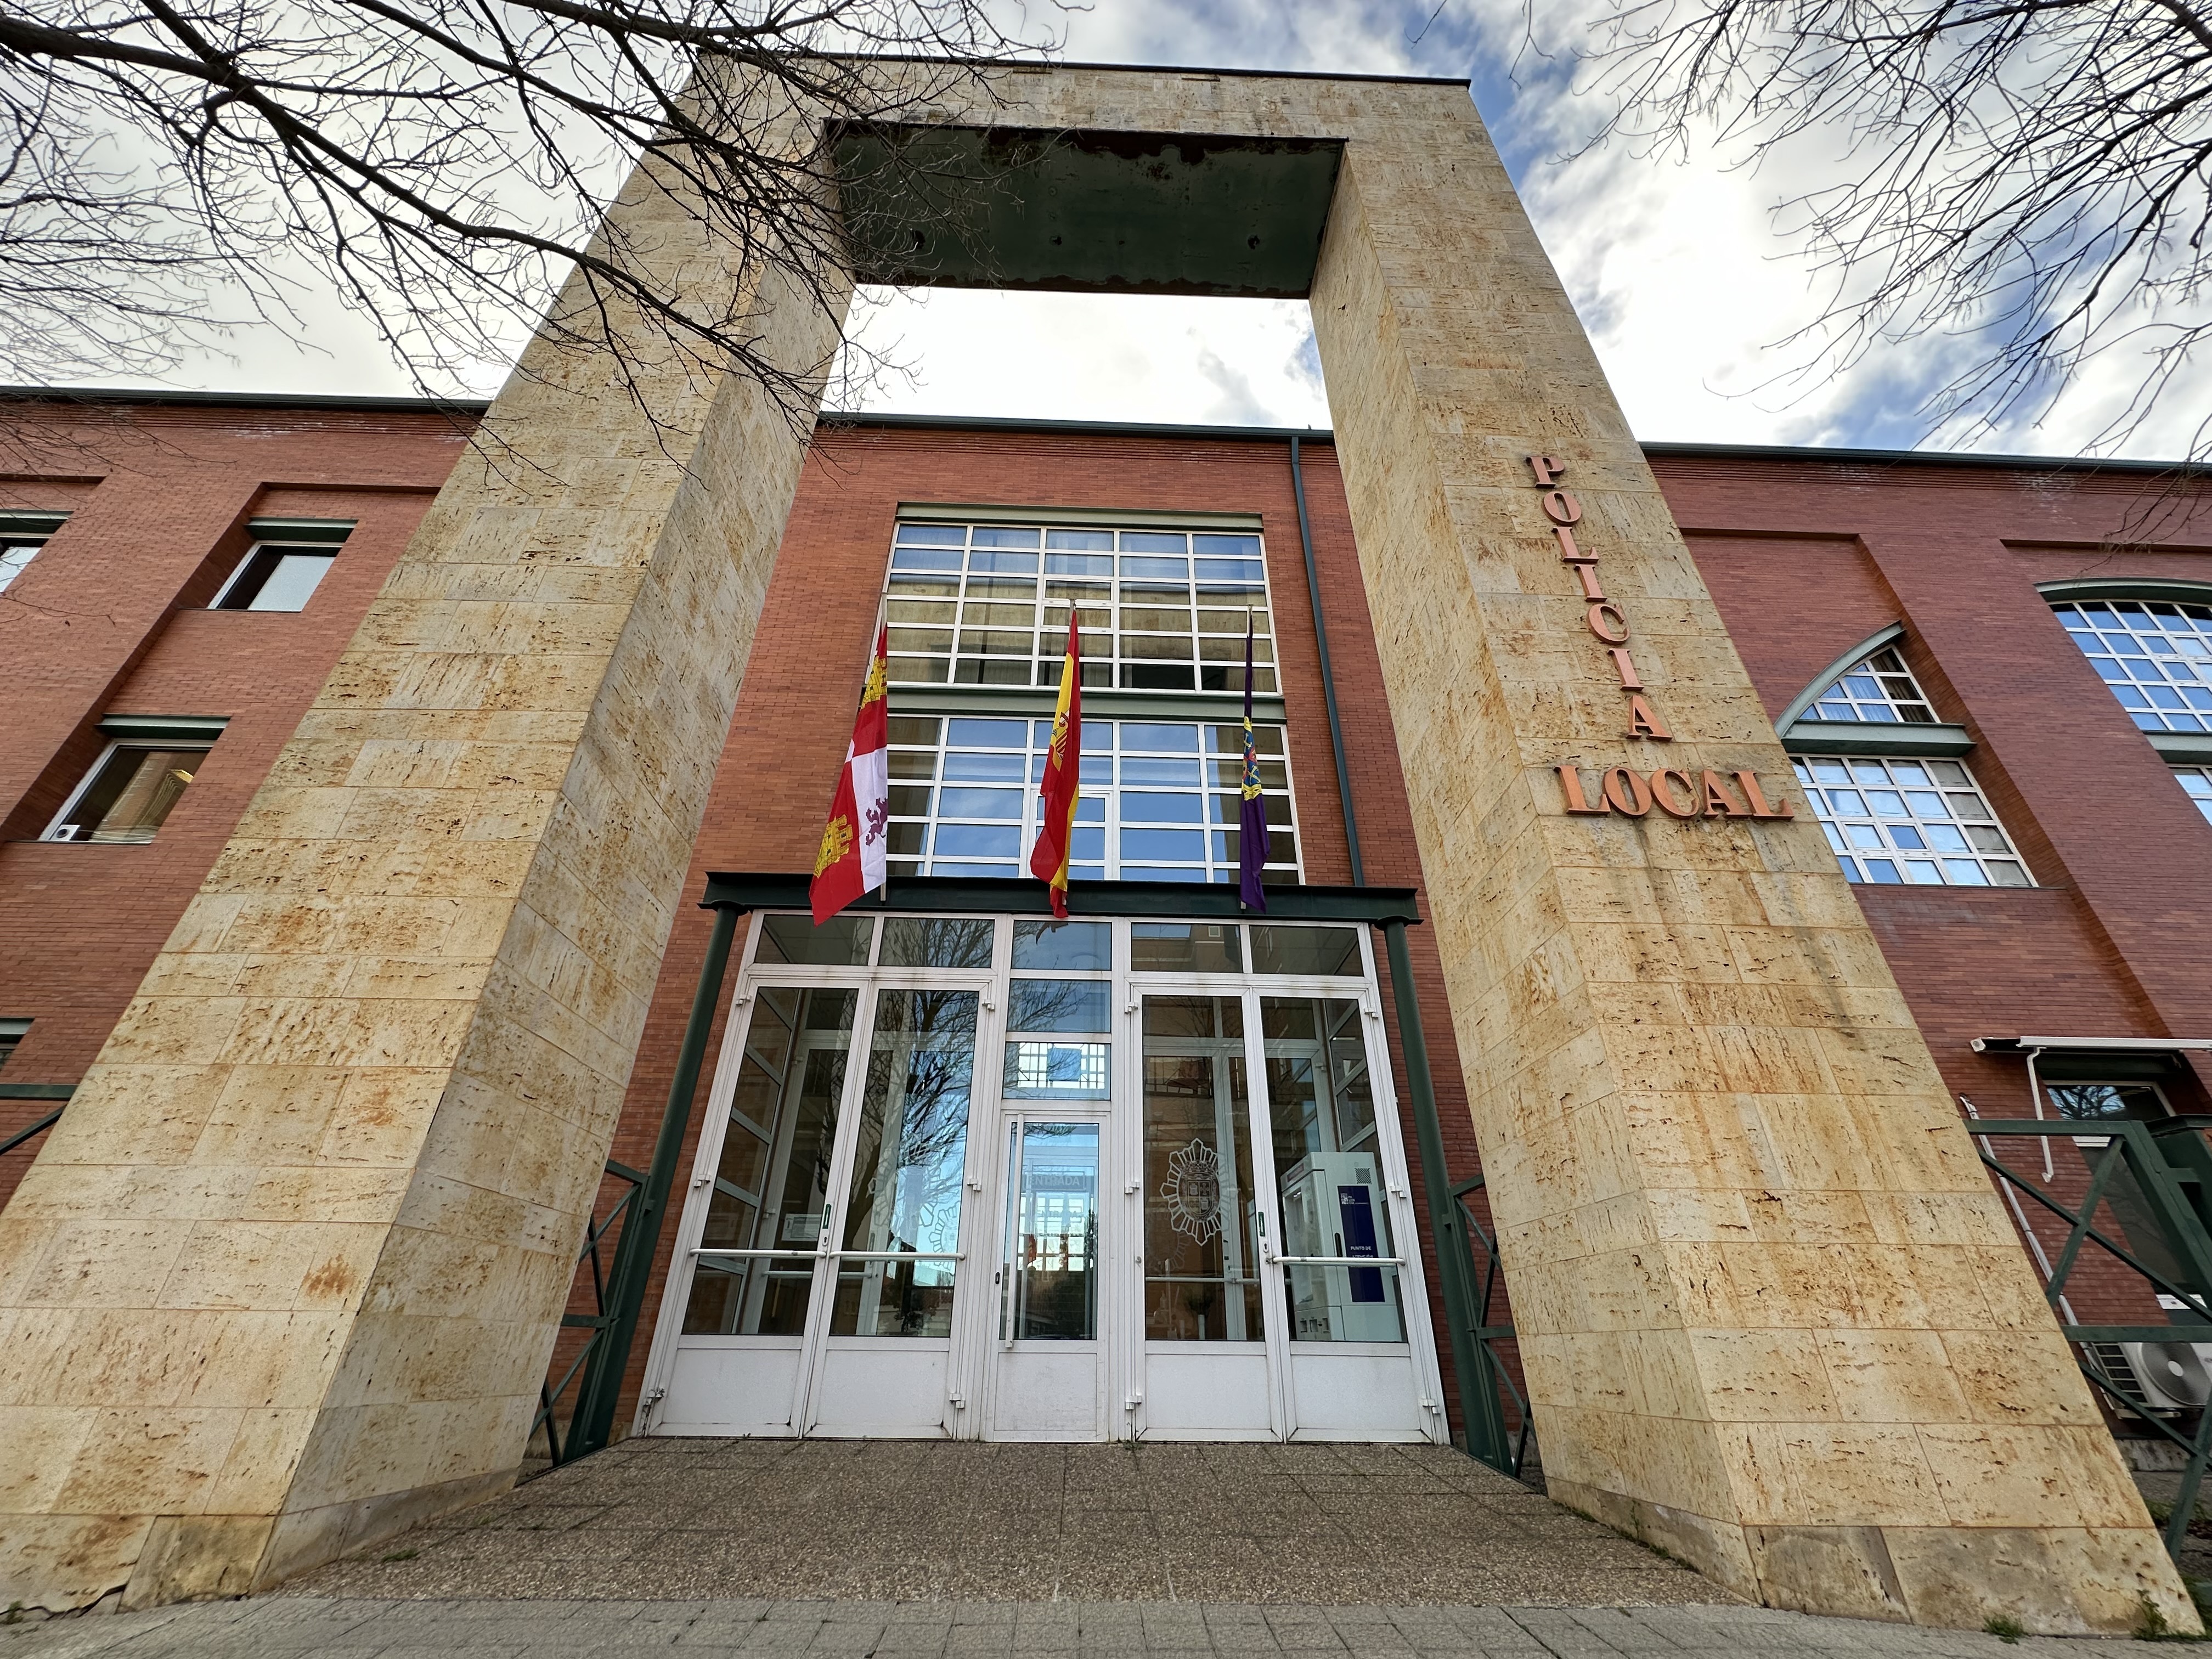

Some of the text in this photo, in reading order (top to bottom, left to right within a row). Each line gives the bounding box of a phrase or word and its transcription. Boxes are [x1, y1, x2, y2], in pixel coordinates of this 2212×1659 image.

[1526, 455, 1673, 741] POLICIA
[1554, 765, 1795, 820] LOCAL
[1029, 1176, 1080, 1186] ENTRADA
